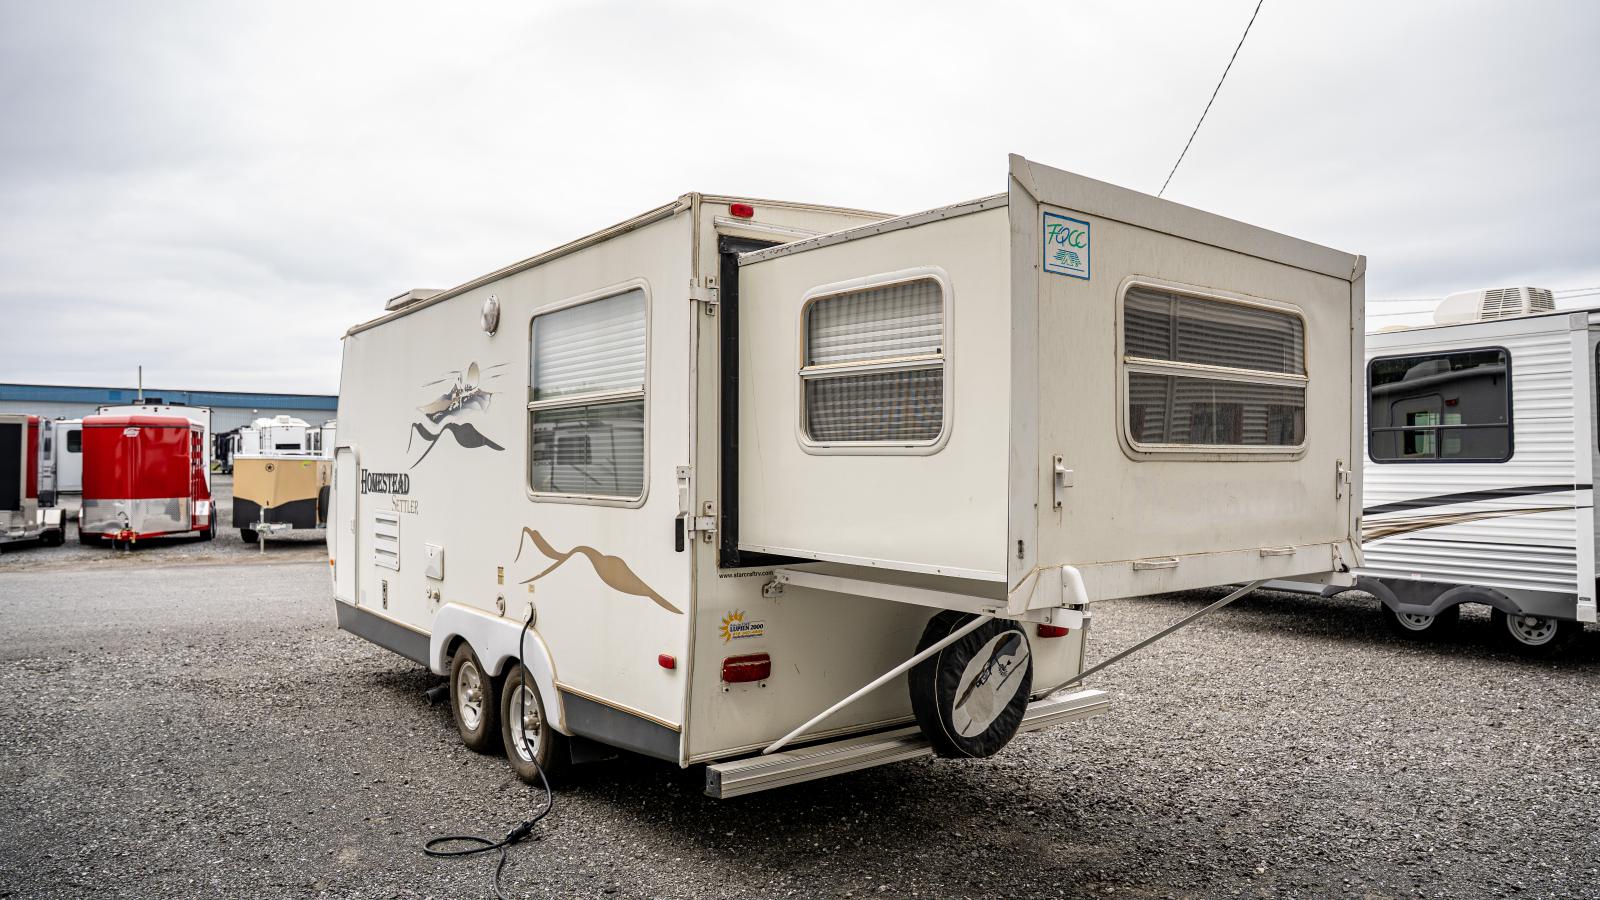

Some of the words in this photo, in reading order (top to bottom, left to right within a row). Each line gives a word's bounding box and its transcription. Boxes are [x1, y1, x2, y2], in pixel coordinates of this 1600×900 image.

[1046, 223, 1087, 248] FQCC
[361, 468, 410, 495] HOMESTEAD
[391, 494, 419, 515] SETTLER
